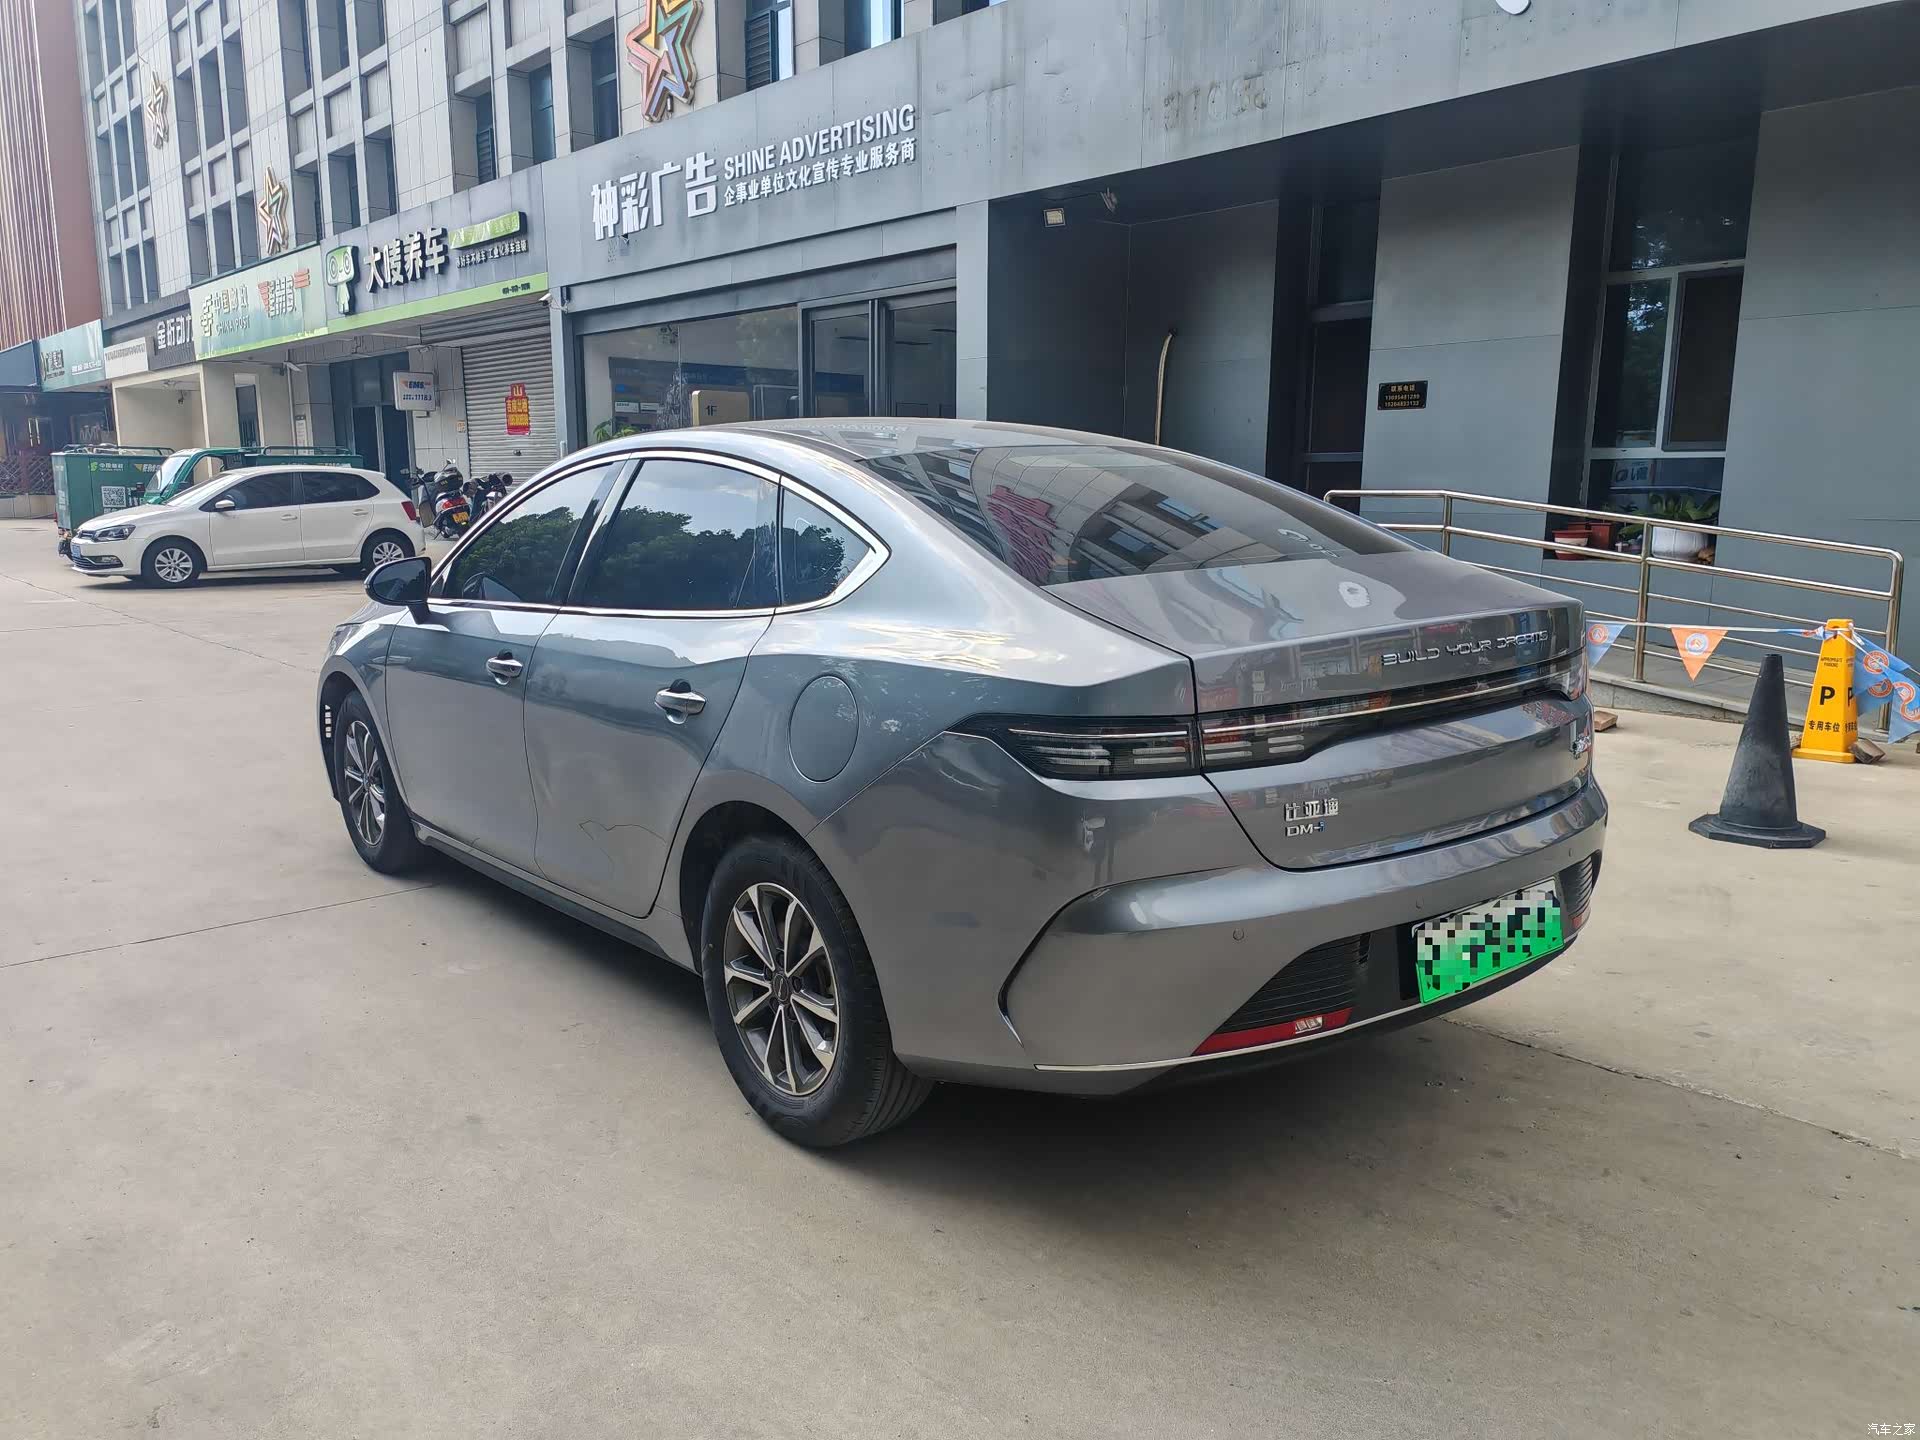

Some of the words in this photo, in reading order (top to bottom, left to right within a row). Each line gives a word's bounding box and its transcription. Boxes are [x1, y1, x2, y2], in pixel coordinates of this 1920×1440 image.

[724, 145, 776, 180] SHINE
[779, 103, 915, 166] ADVERTISING
[723, 137, 916, 207] 企事业单位文化宣传专业服务商
[591, 152, 719, 241] 神彩广告
[706, 404, 718, 416] 1F
[1382, 648, 1440, 666] BUILD
[1445, 640, 1492, 656] YOUR
[1496, 630, 1548, 649] DREAMS
[1819, 686, 1836, 705] P
[1808, 719, 1841, 732] 专用车位
[1284, 798, 1339, 822] 比亚迪
